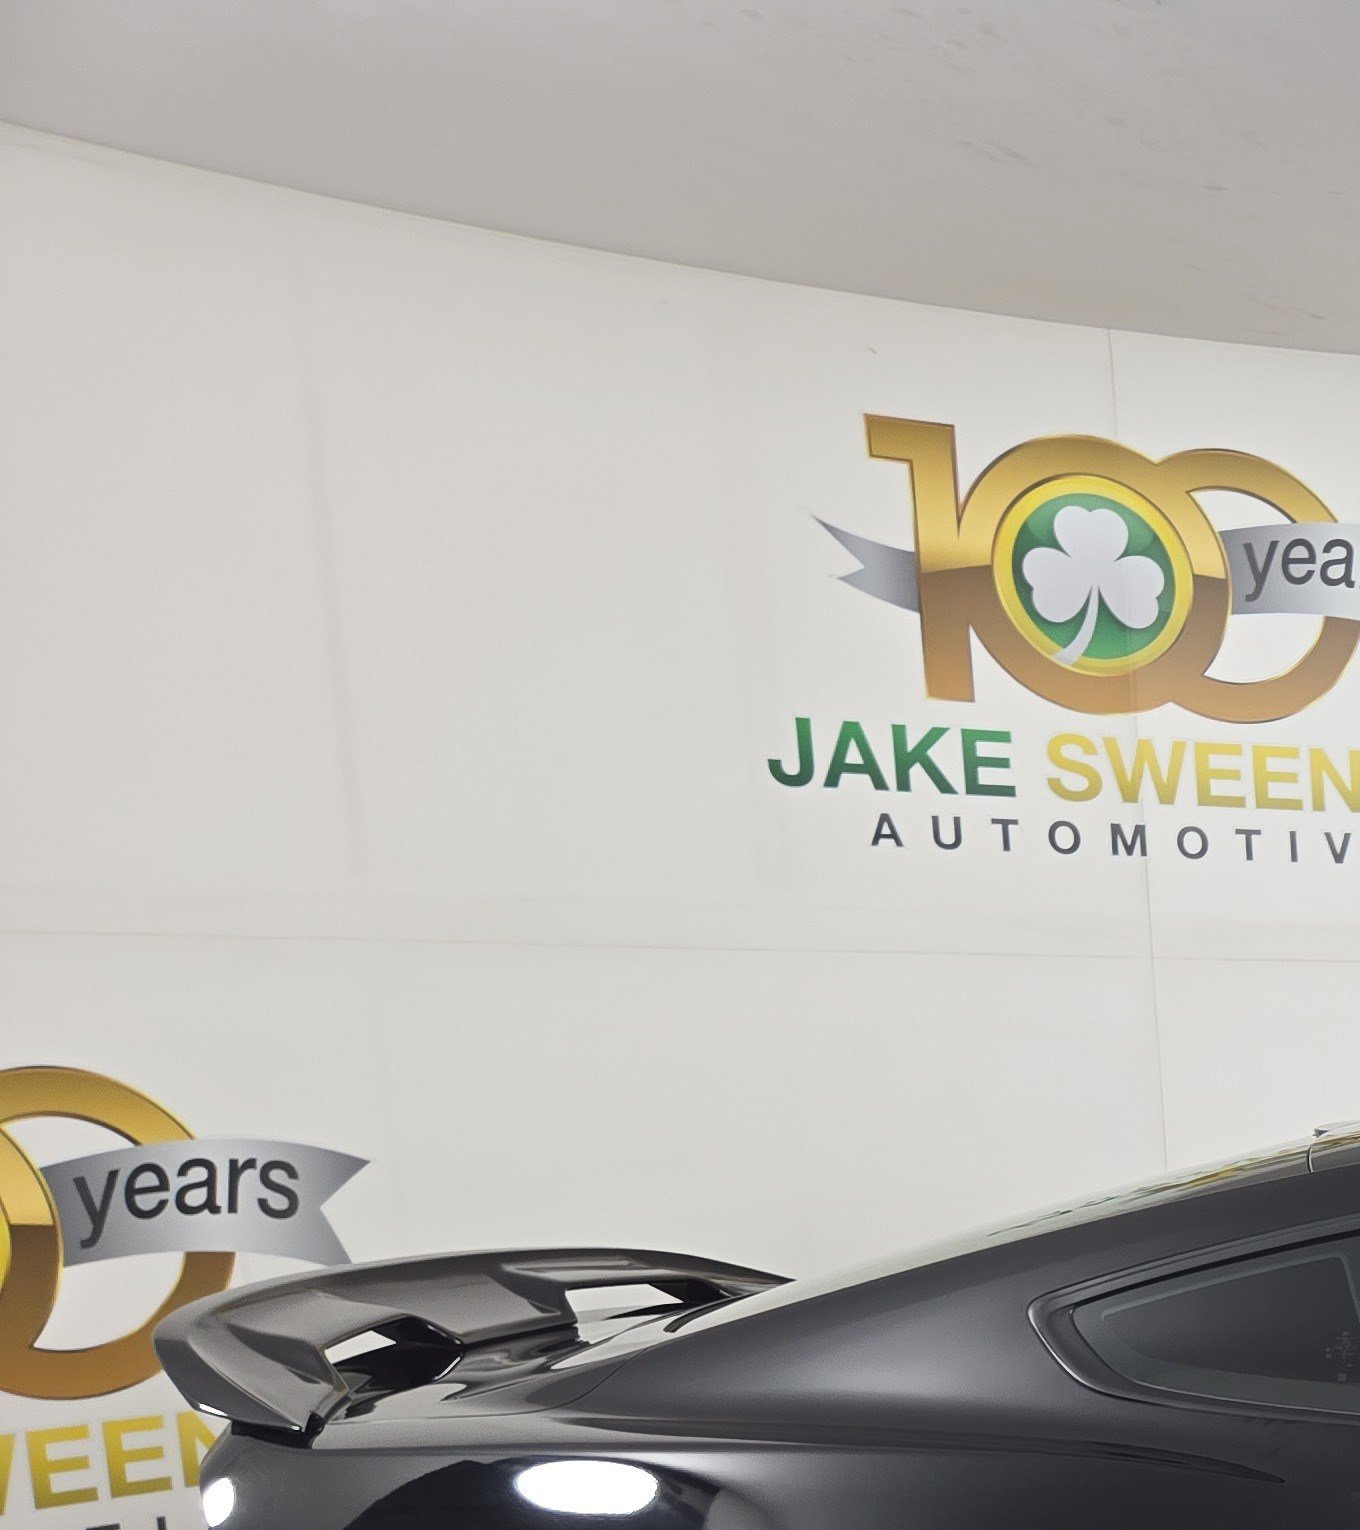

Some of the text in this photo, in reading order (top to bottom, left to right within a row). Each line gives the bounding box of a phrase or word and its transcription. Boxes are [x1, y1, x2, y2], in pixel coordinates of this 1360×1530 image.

[767, 716, 1017, 798] JAKE
[73, 1157, 301, 1249] years
[0, 1411, 217, 1516] EE
